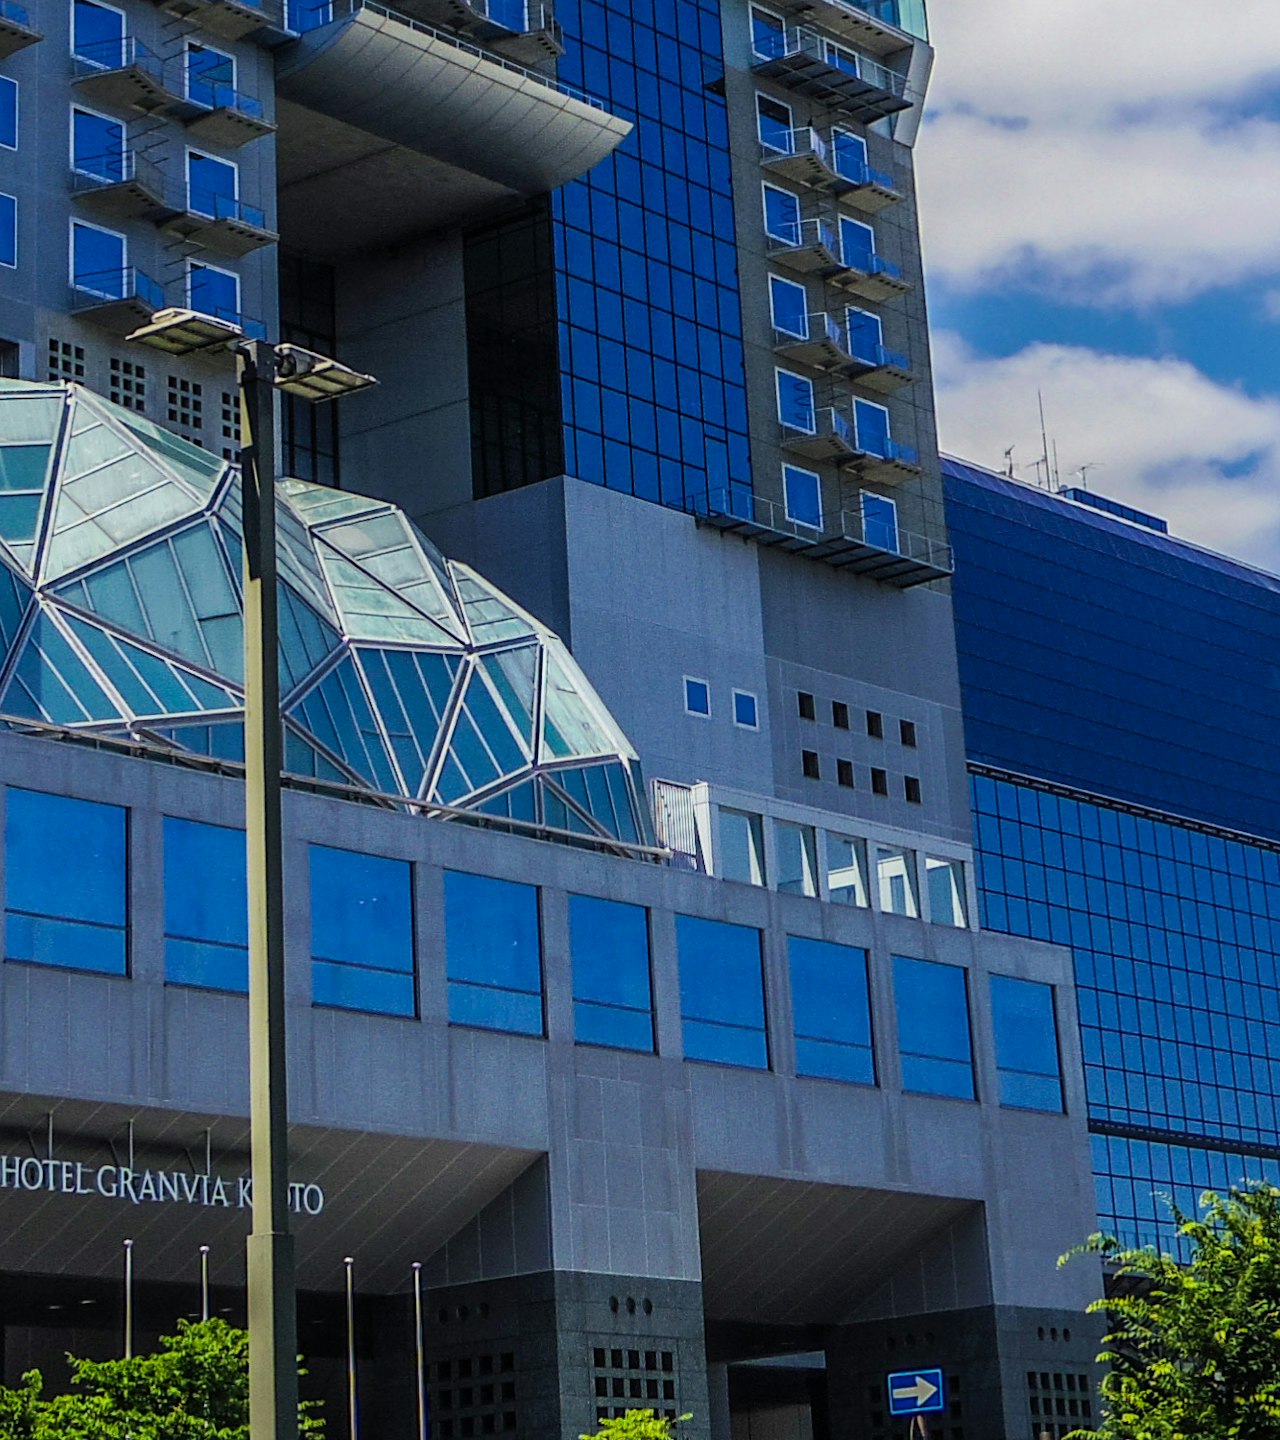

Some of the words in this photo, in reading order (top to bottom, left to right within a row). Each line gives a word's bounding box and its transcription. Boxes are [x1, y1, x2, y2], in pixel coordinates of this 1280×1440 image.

[0, 1155, 92, 1195] HOTEL
[96, 1165, 229, 1208] GRANVIA
[237, 1176, 324, 1215] KTO
